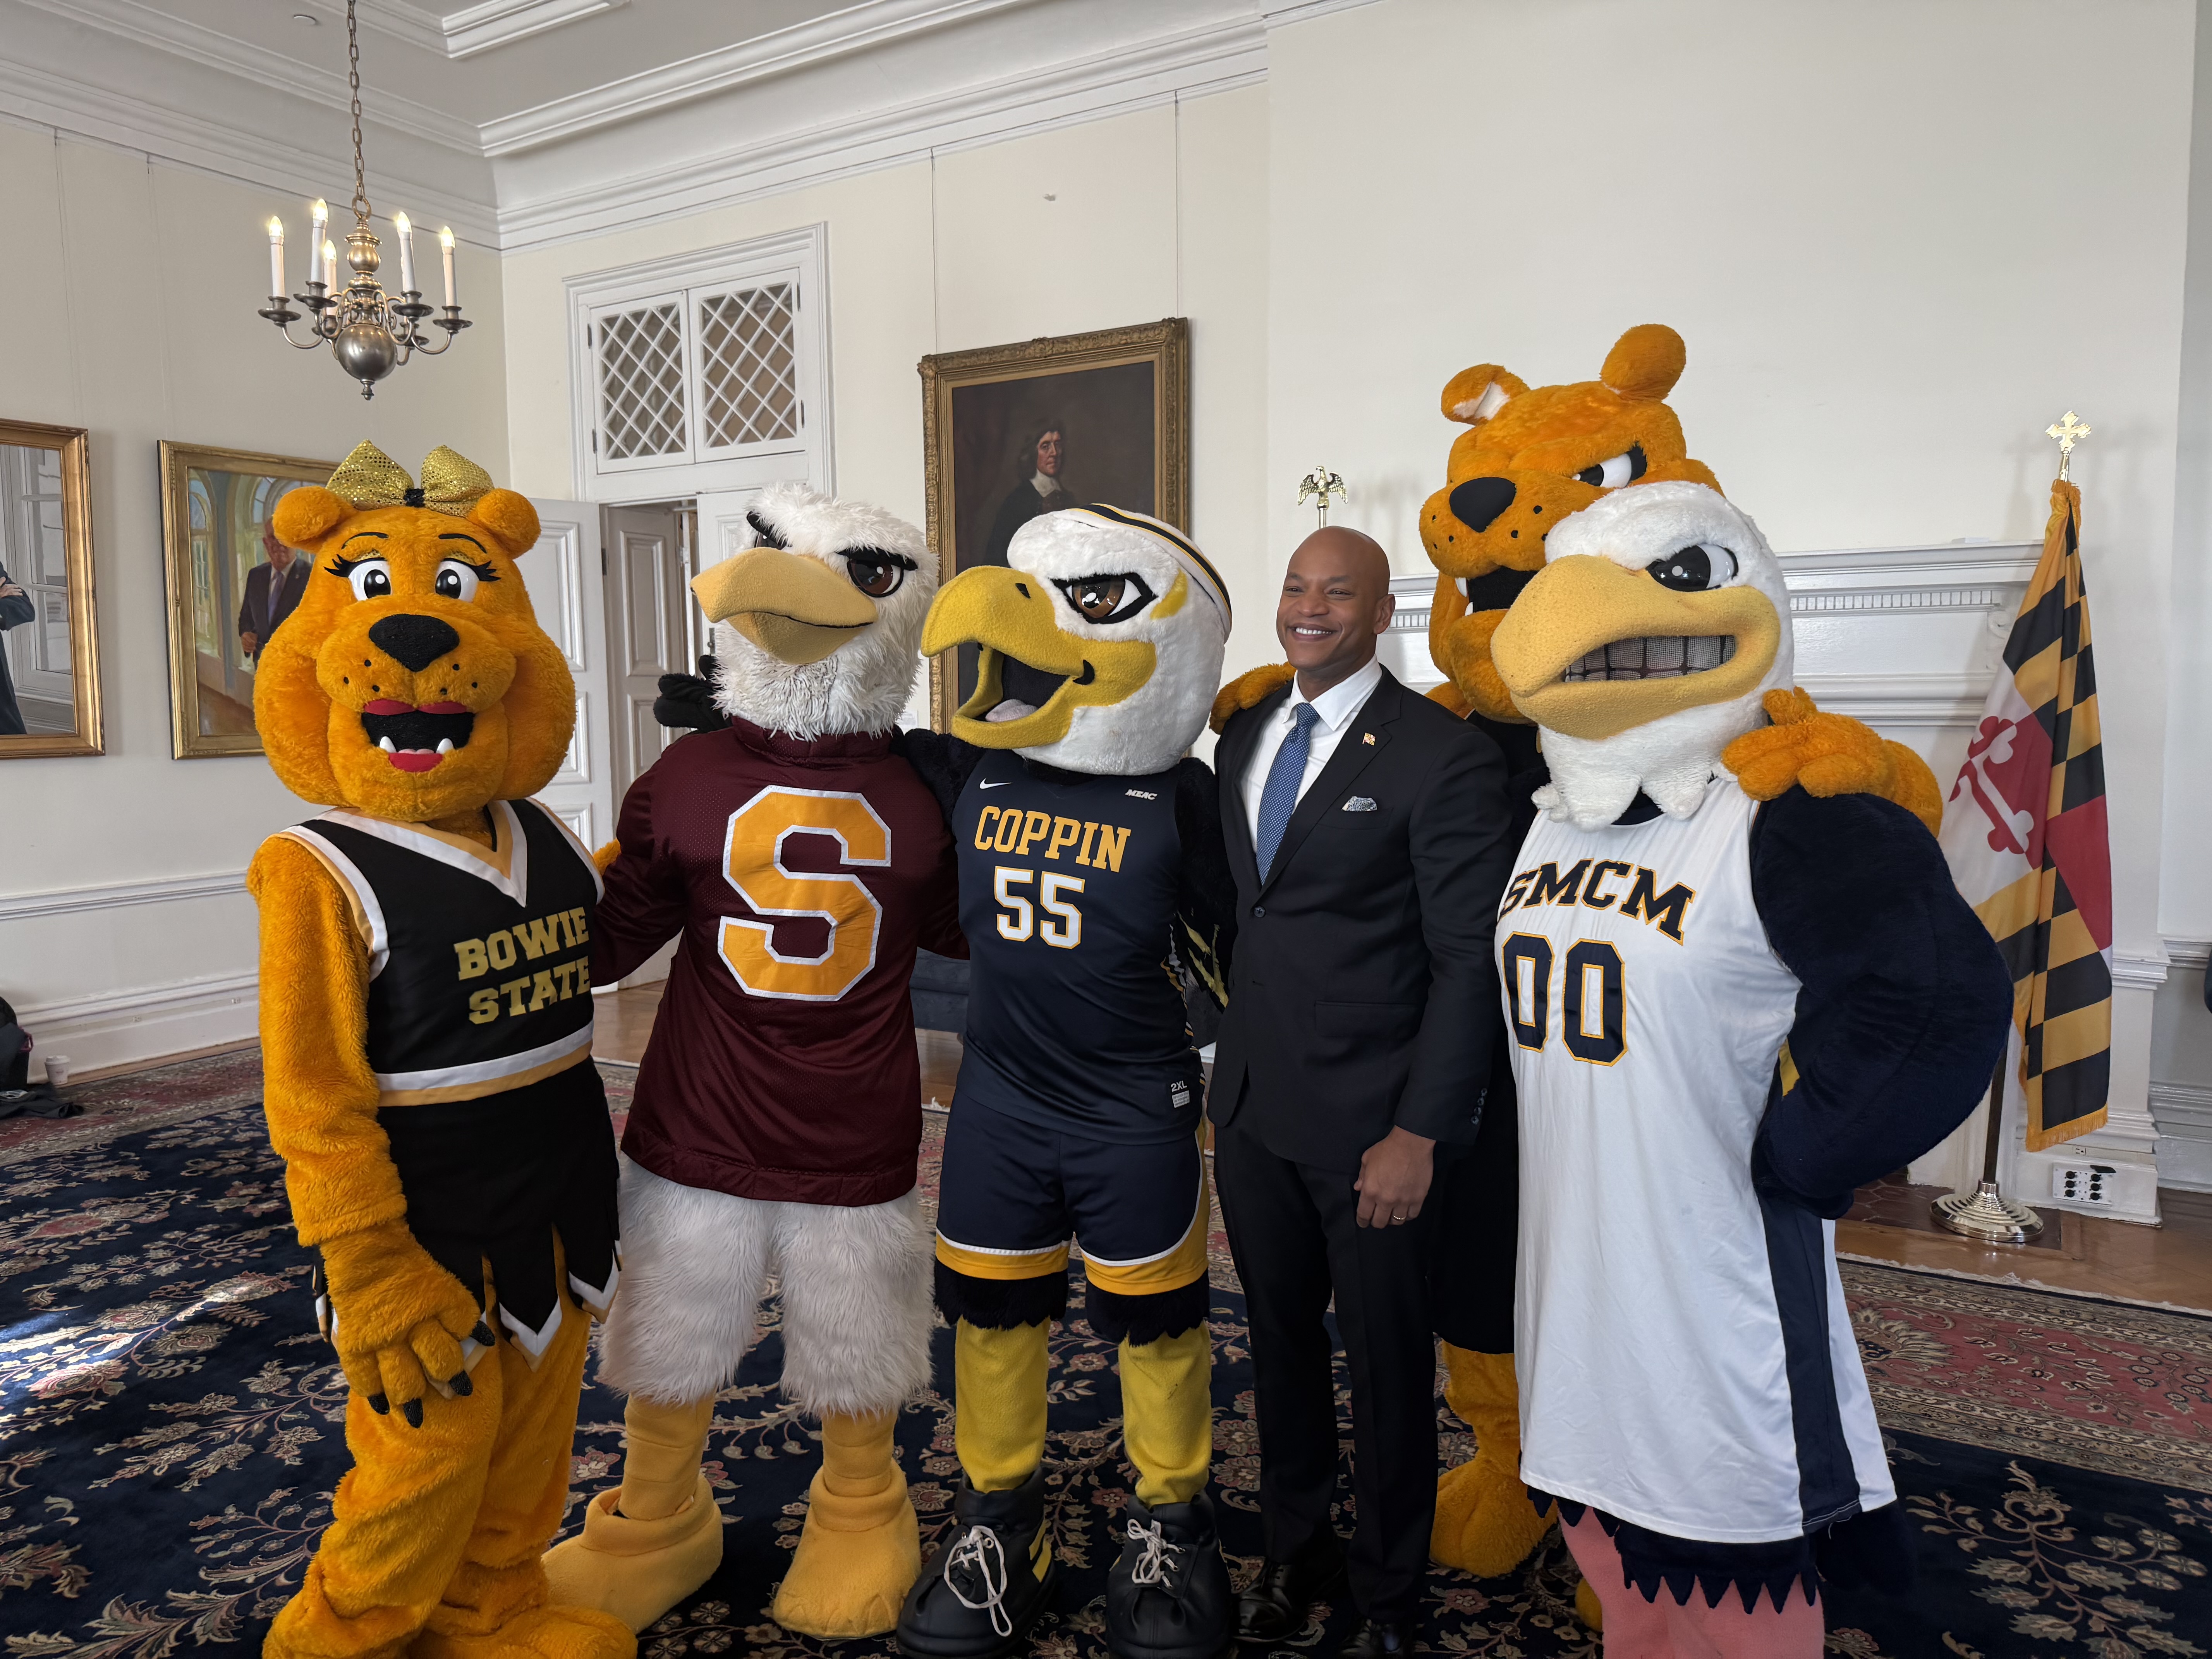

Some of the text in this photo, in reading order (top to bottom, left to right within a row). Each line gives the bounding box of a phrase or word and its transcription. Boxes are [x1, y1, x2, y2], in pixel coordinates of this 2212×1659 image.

[1125, 789, 1158, 800] MEAC
[974, 805, 1131, 872] COPPIN
[718, 785, 891, 1001] S
[994, 866, 1085, 949] 55
[1496, 857, 1696, 946] SMCM
[453, 906, 589, 981] BOWIE
[469, 955, 591, 1025] STATE
[1501, 931, 1628, 1066] 00
[1171, 1080, 1187, 1092] 2XL
